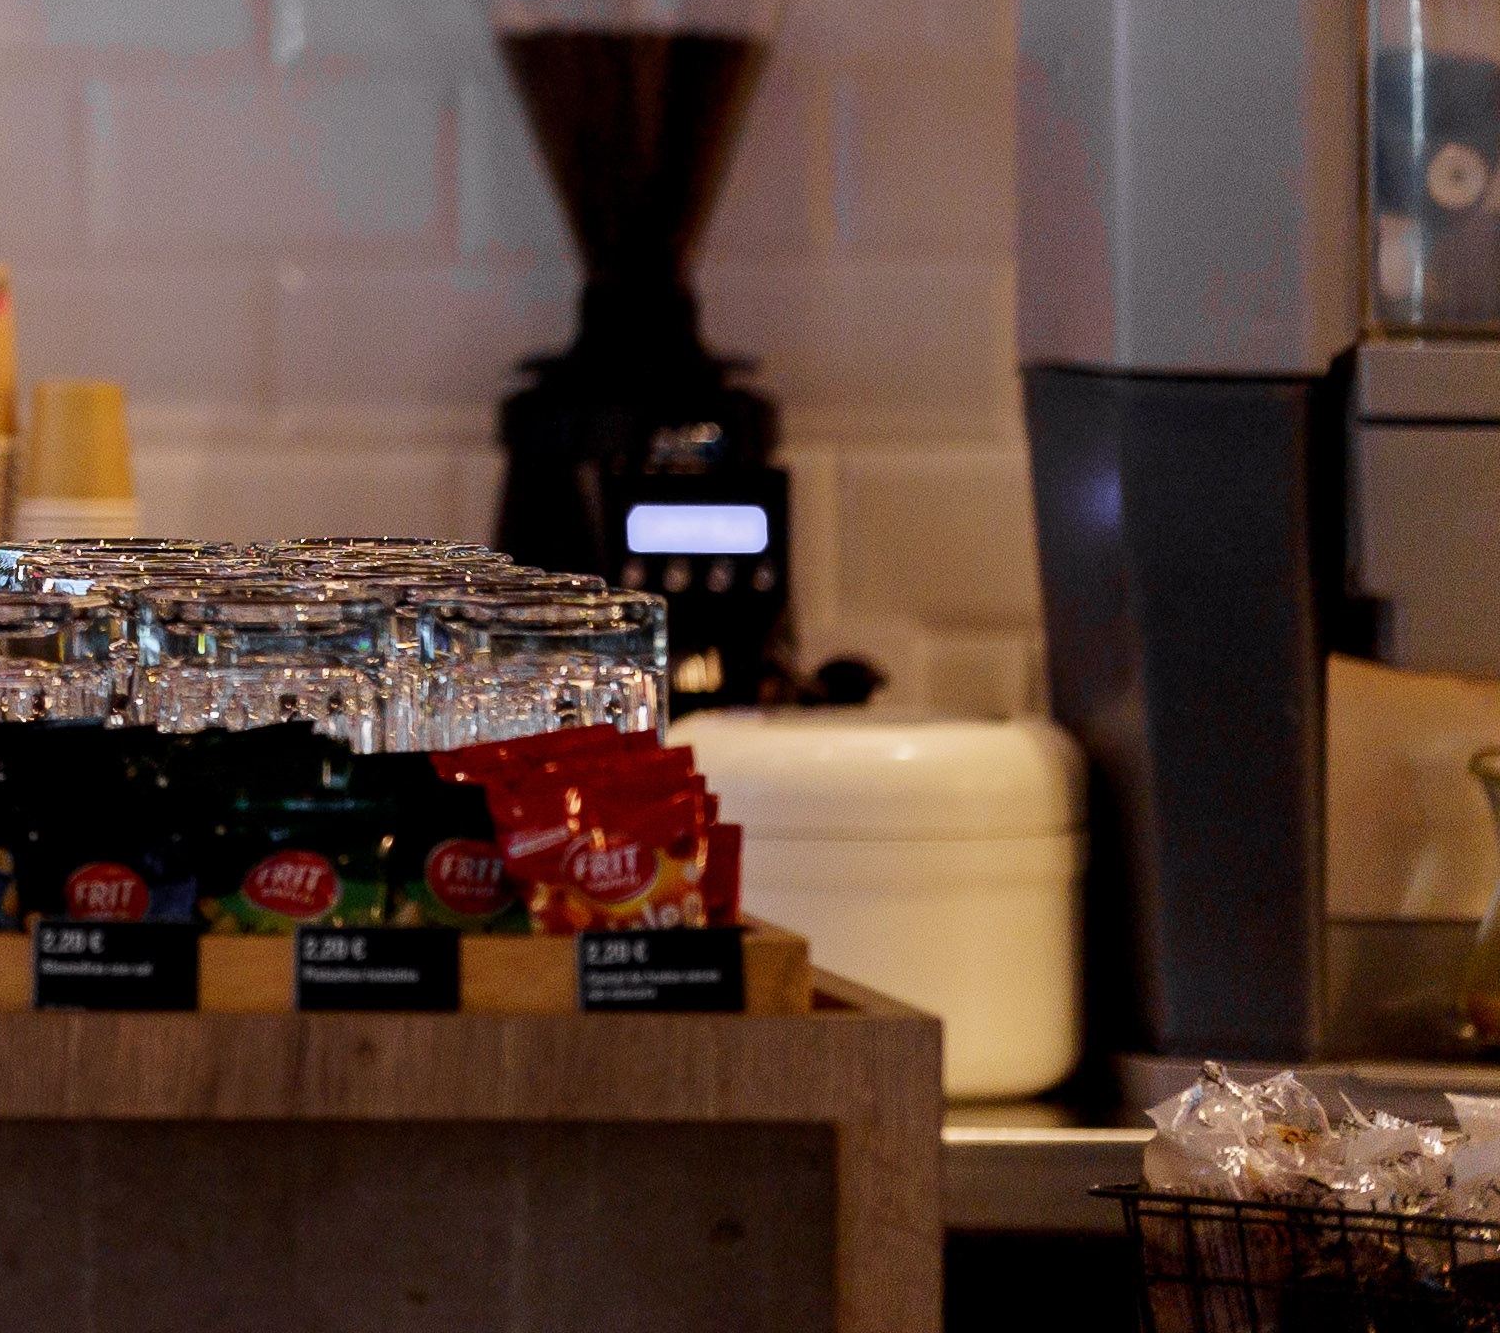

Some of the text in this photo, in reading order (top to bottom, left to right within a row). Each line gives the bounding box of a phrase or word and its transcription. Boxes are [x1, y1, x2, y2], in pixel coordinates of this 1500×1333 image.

[255, 862, 328, 893] FRIT
[572, 843, 639, 881] FRIT
[75, 878, 135, 908] FRIT
